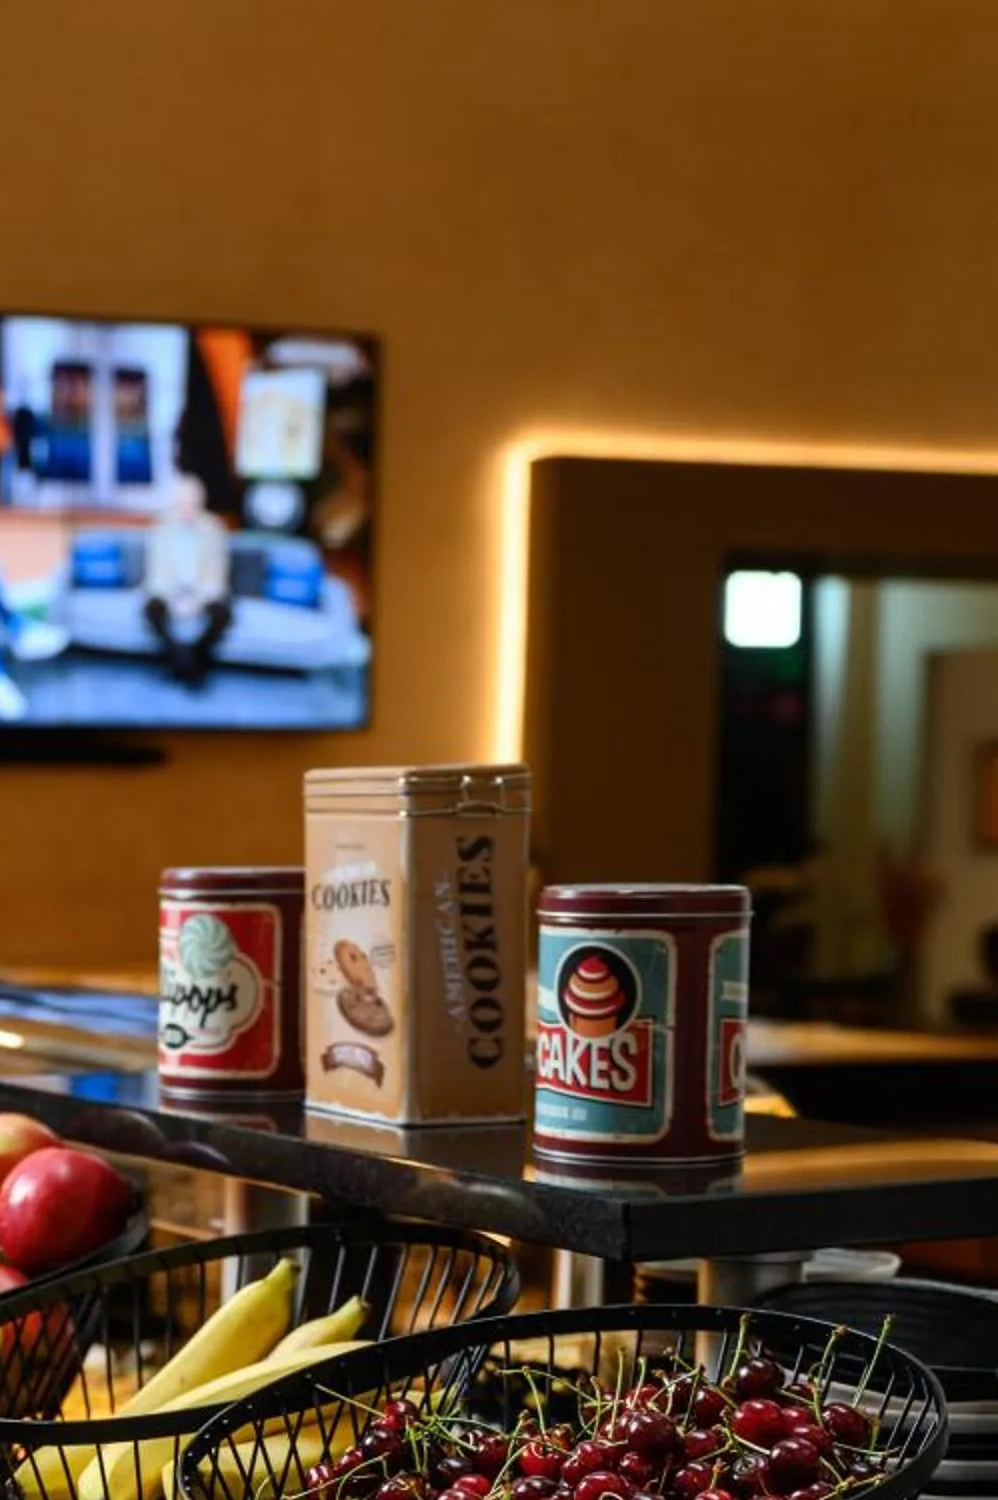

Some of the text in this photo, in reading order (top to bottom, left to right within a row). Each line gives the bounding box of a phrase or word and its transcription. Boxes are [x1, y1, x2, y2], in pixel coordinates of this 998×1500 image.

[310, 879, 391, 912] COOKIES
[434, 878, 467, 1022] AMERICAN
[455, 835, 505, 1069] COOKIES
[537, 1031, 638, 1092] CAKES
